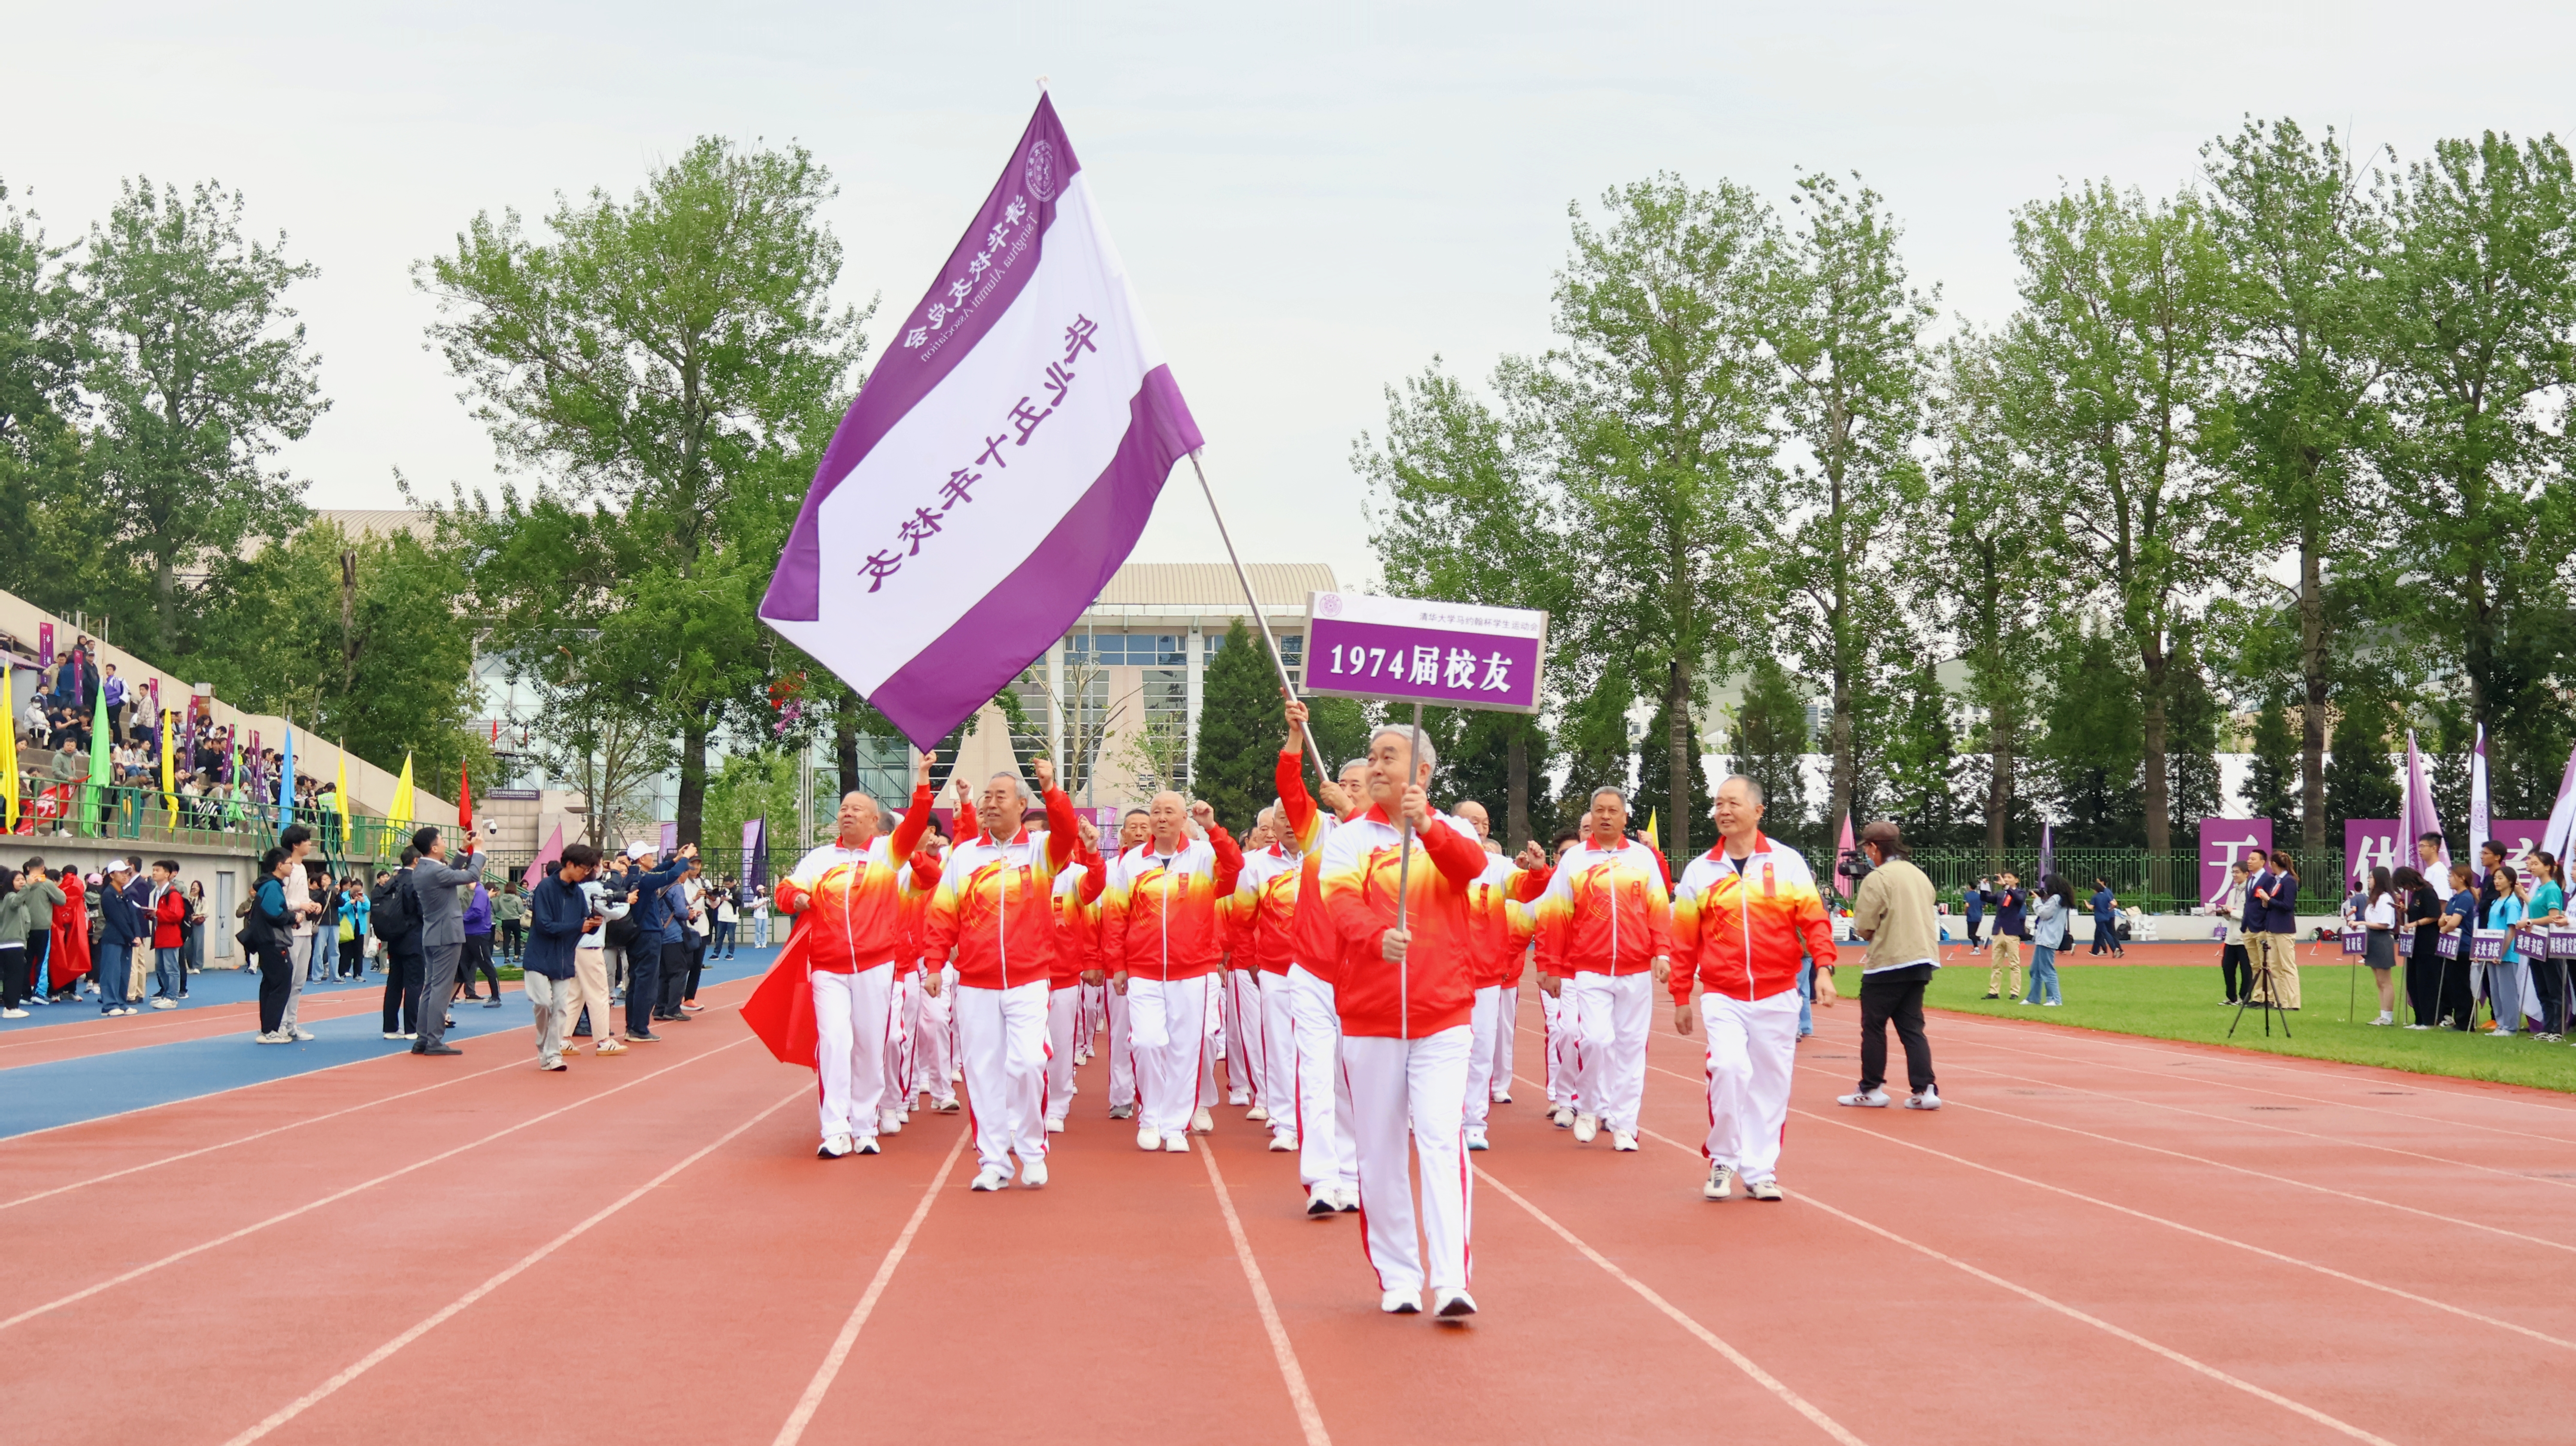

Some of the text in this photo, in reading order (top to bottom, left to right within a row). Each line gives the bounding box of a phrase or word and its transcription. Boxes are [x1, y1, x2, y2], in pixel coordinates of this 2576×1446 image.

[1419, 612, 1539, 632] 清华大学马约翰杯学生运动会
[1330, 644, 1513, 693] 1974届校友
[2473, 941, 2500, 957] 未央书院
